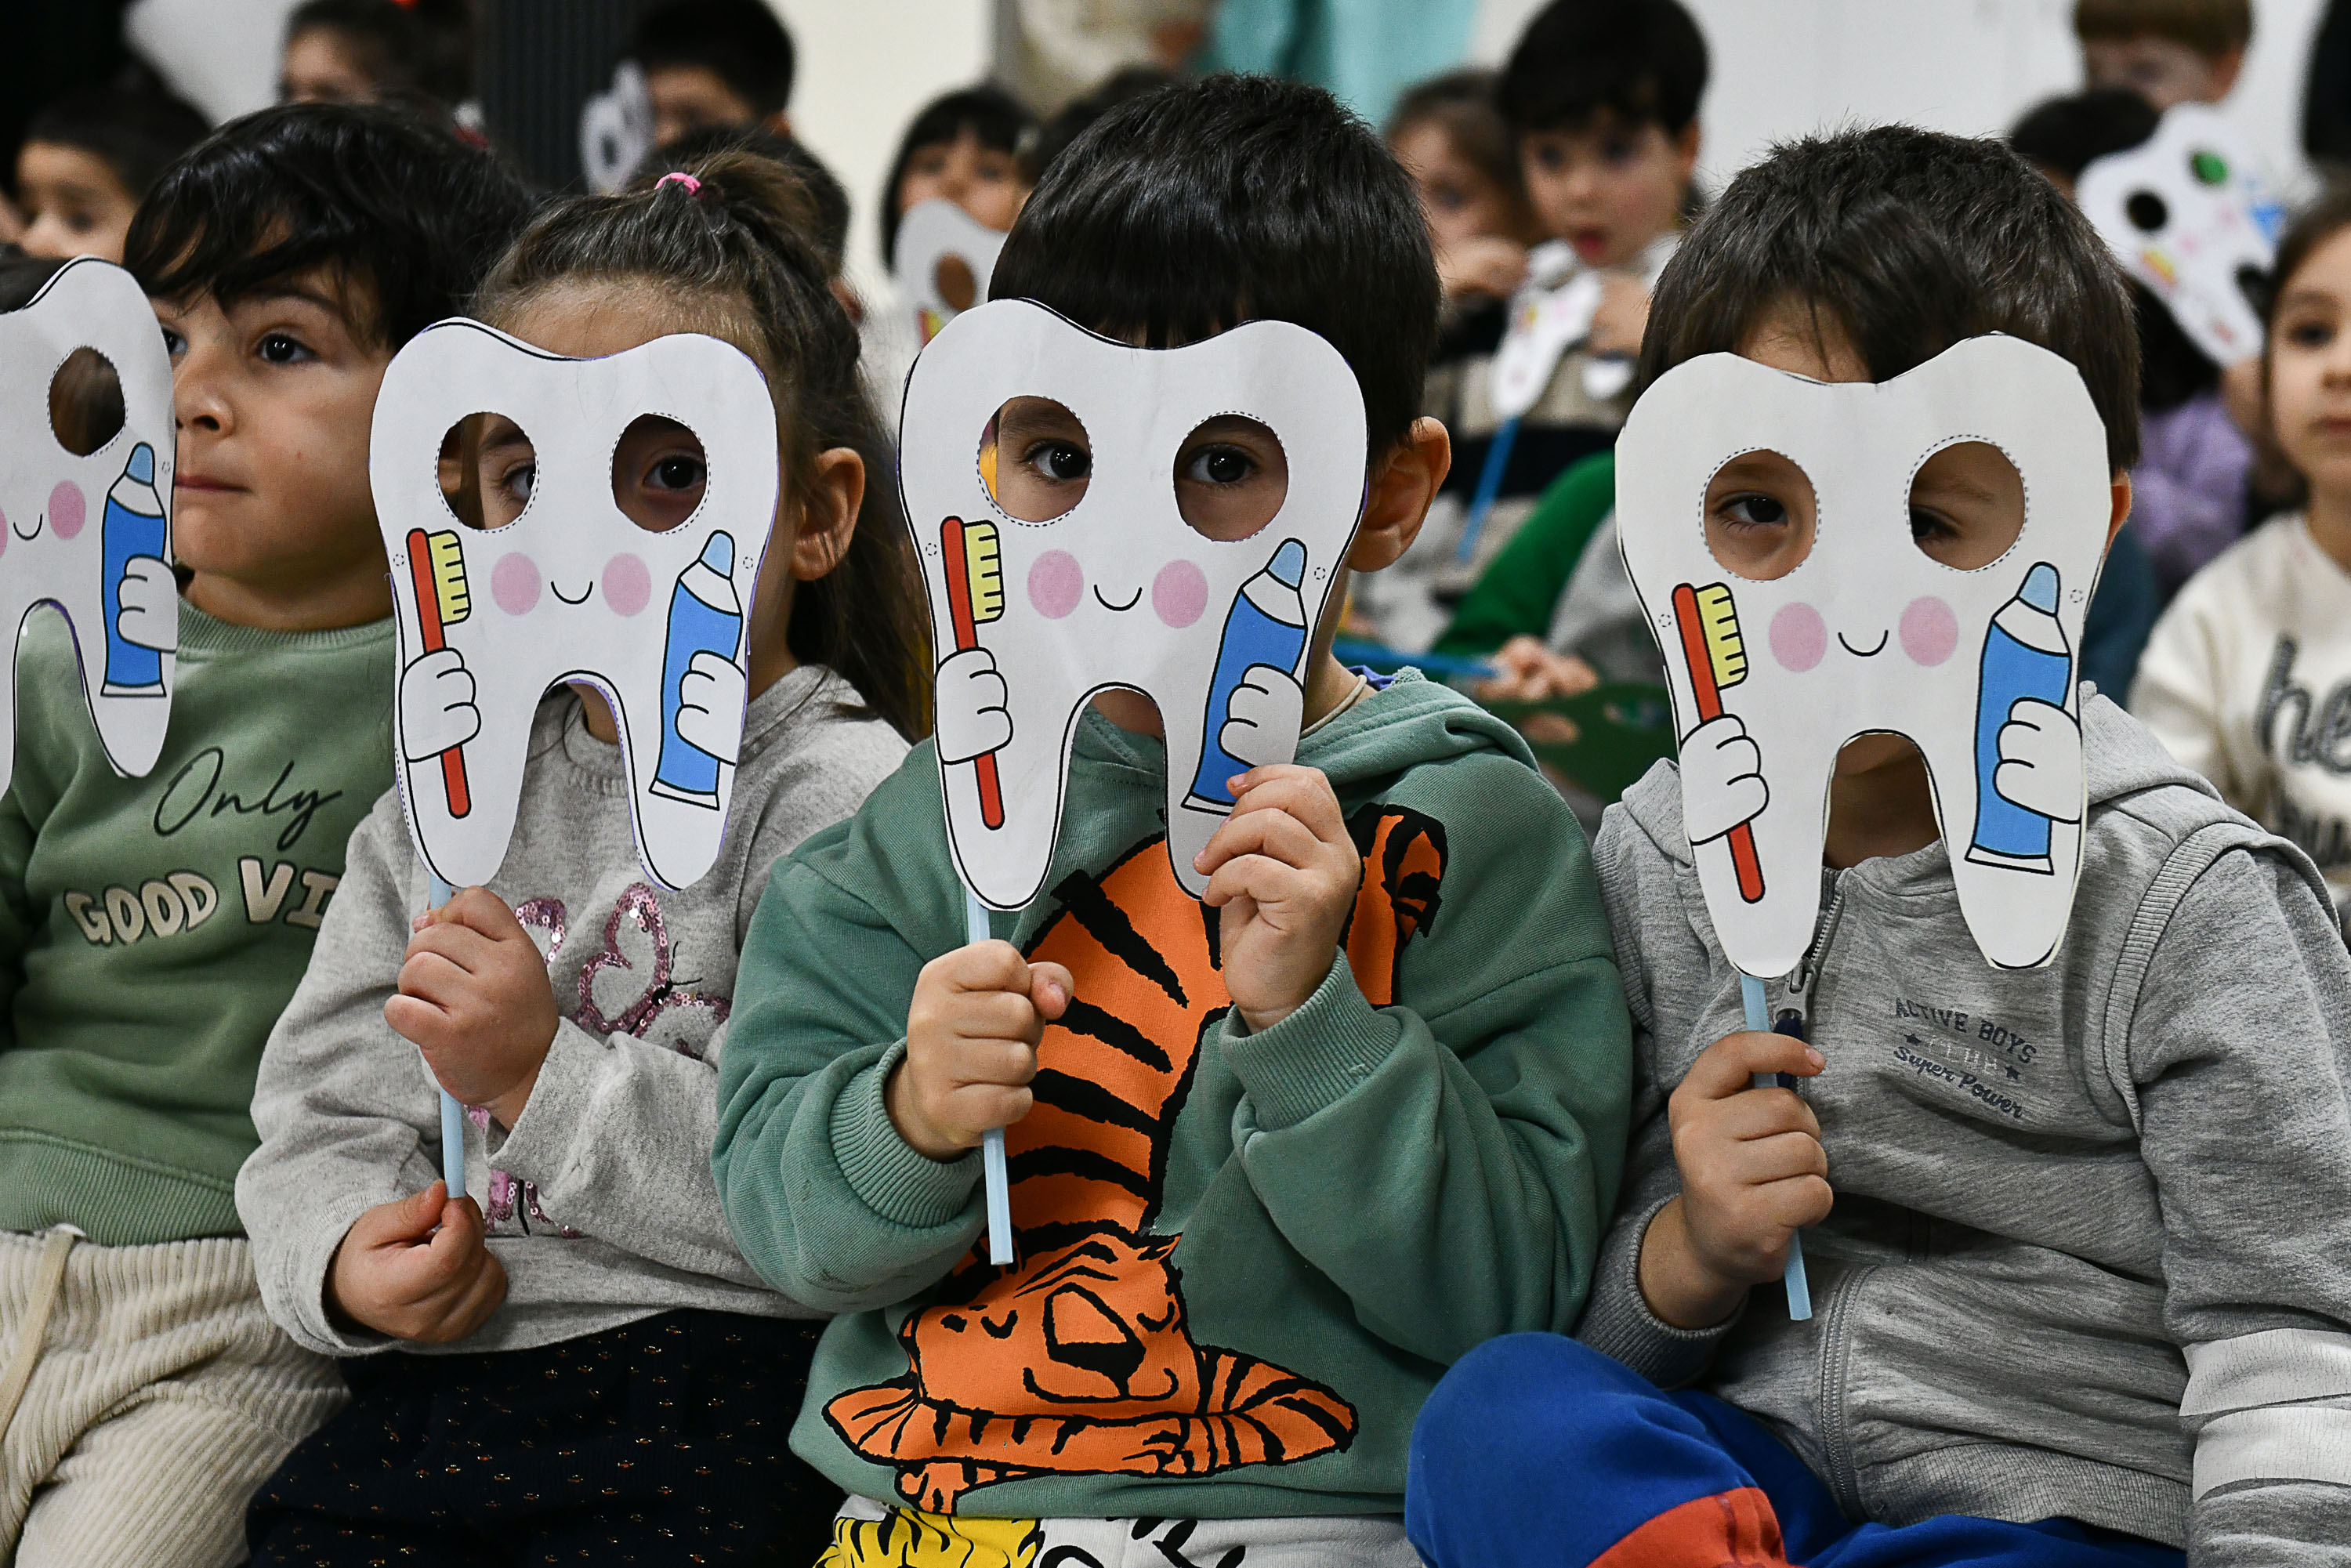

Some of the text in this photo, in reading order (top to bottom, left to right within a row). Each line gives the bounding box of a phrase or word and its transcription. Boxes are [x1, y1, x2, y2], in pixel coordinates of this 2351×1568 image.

[154, 747, 342, 850] Only
[63, 869, 218, 945] GOOD
[1894, 996, 2038, 1064] ACTIVE BOYS
[1893, 1046, 2023, 1118] Super Power
